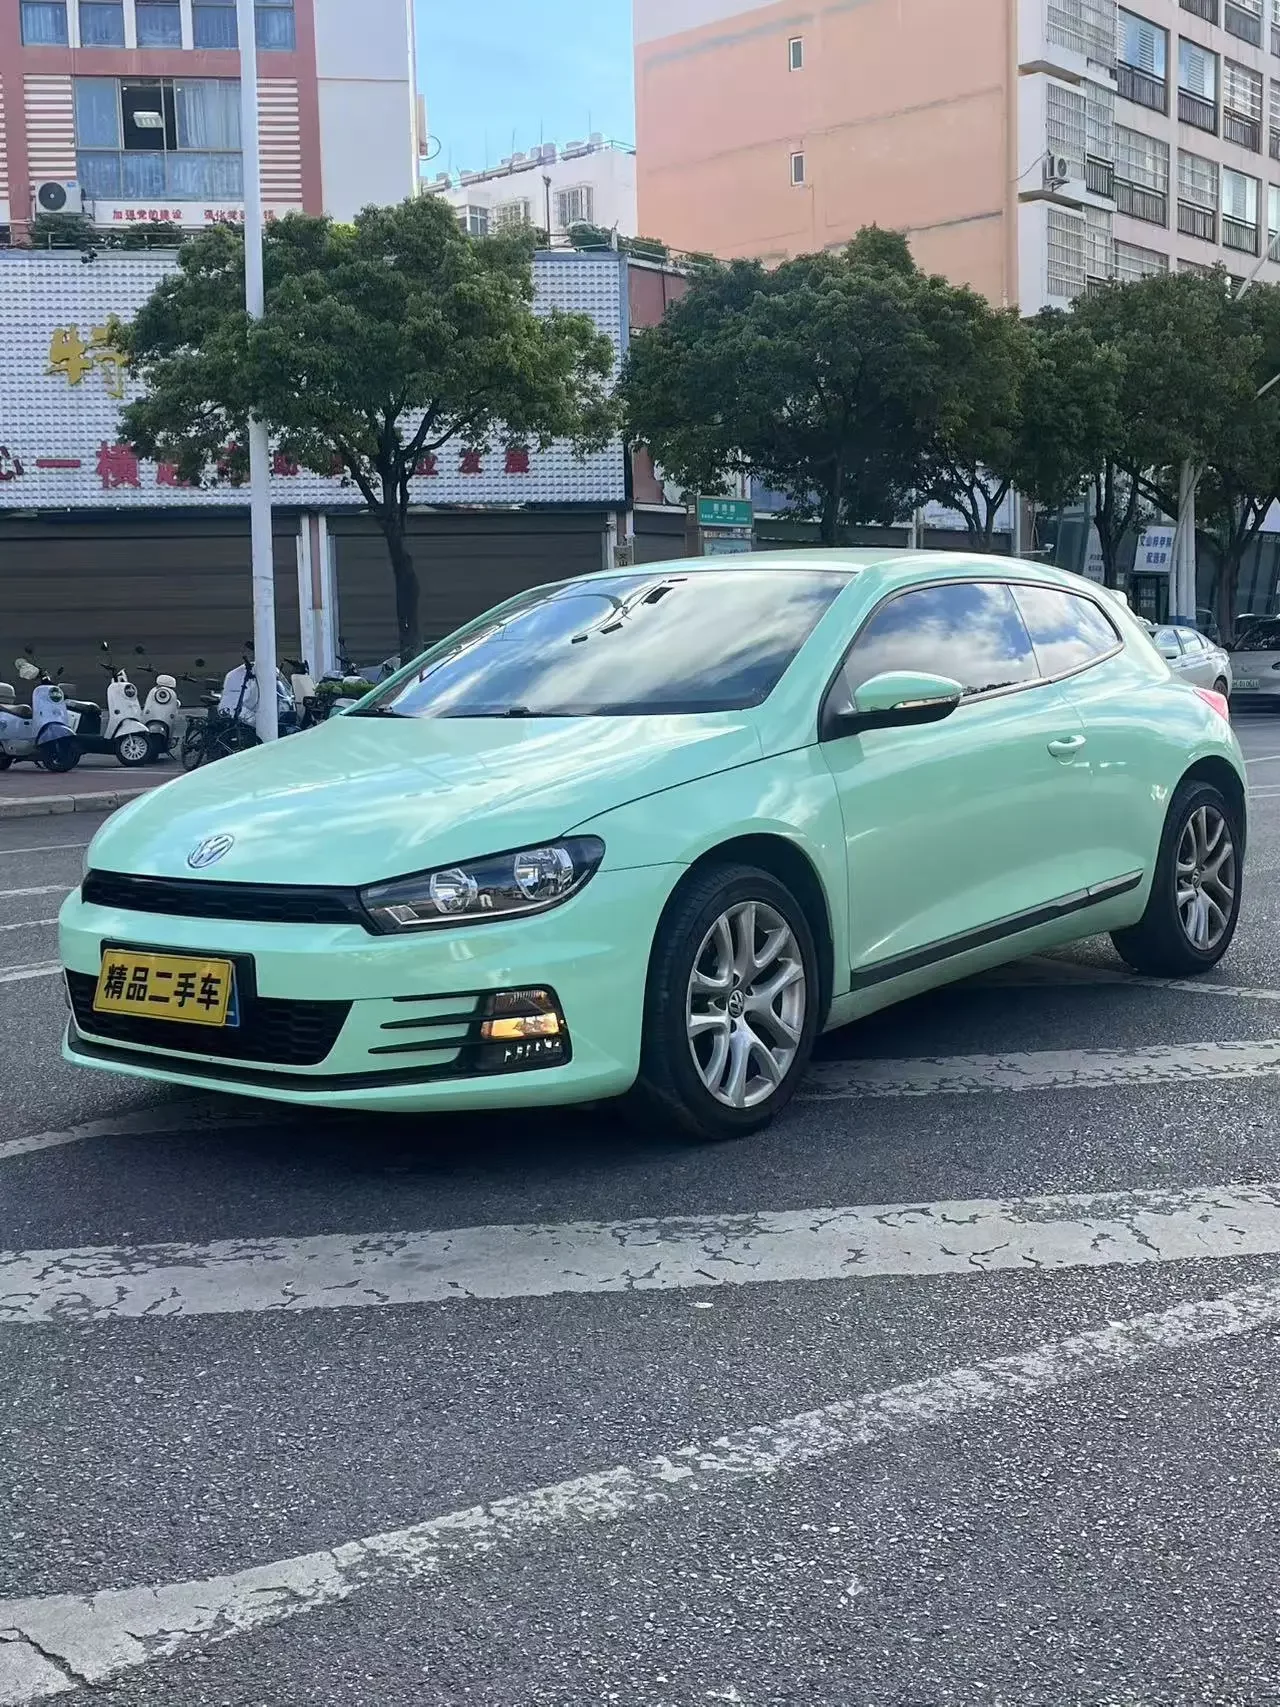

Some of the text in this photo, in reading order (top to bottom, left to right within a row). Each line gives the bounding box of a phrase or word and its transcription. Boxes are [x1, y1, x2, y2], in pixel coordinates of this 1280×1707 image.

[104, 963, 221, 1010] 精品二手车
